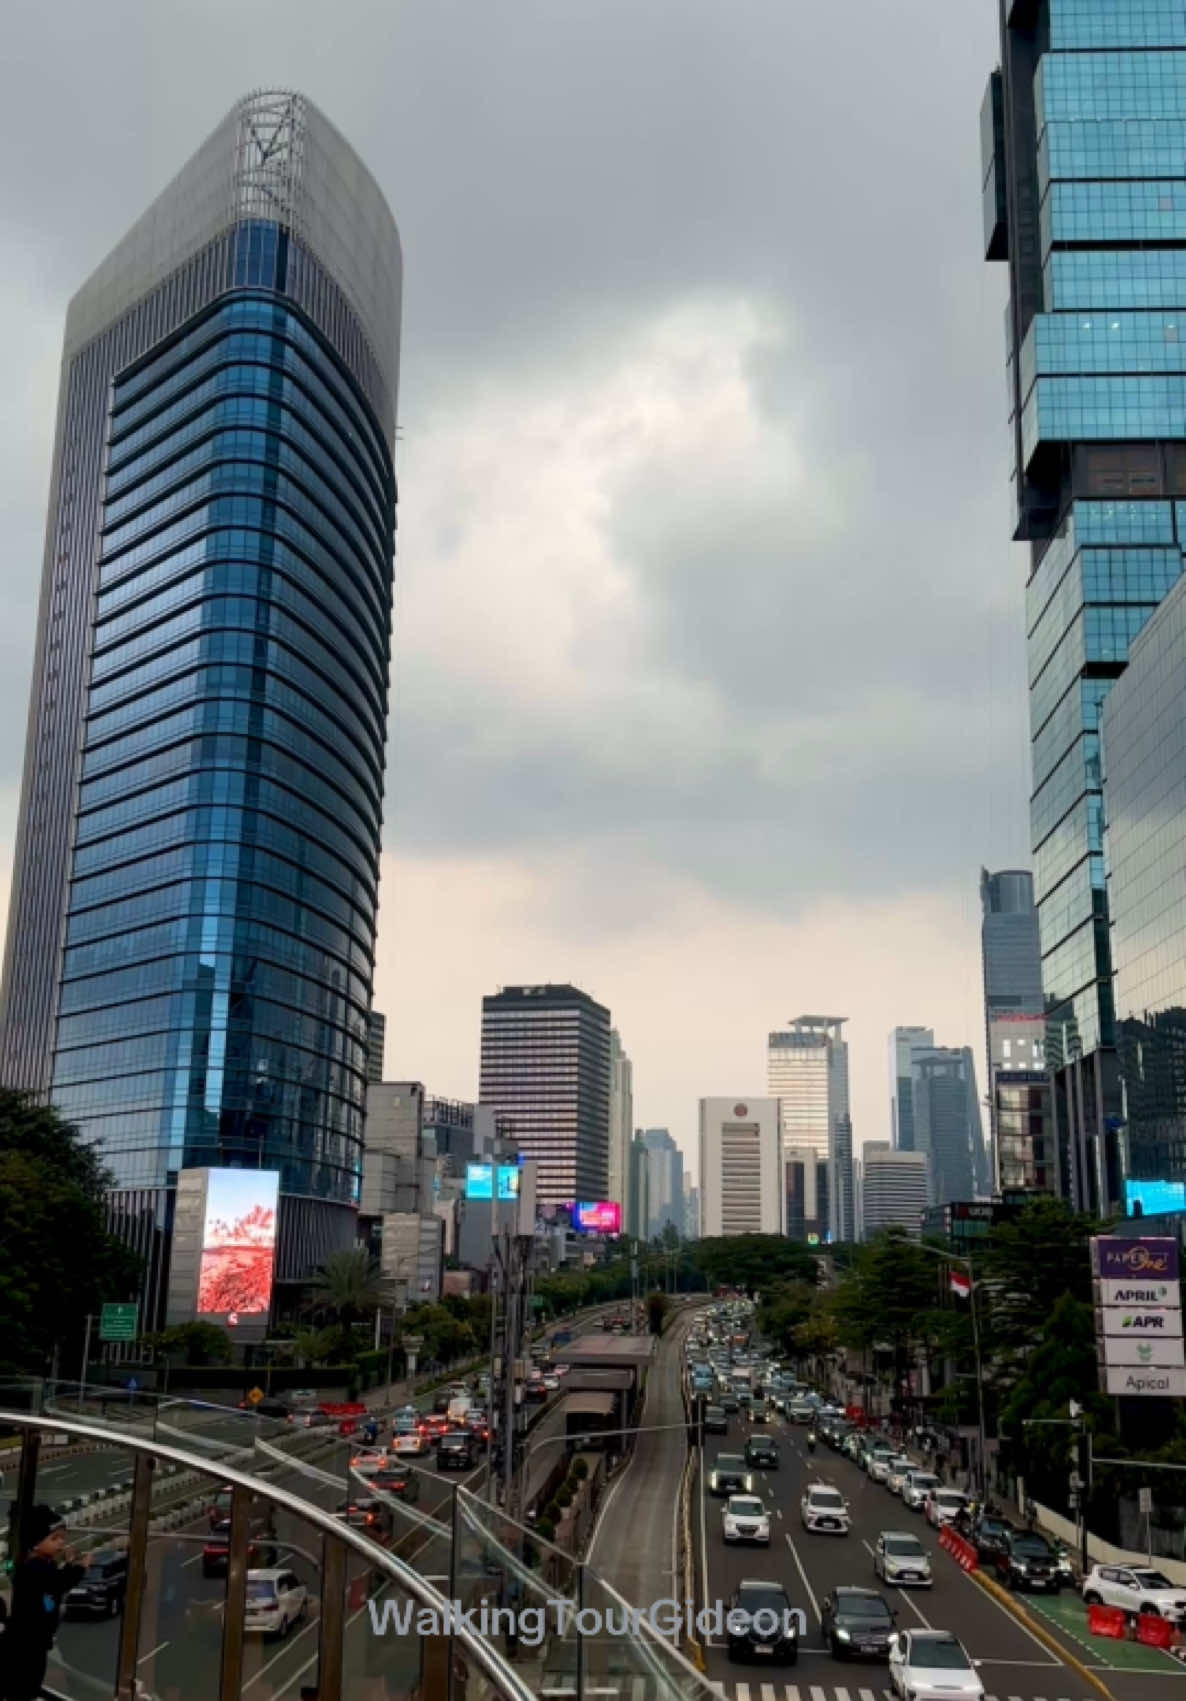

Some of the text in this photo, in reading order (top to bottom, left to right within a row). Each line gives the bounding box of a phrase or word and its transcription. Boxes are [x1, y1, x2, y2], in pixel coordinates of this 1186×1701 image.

[1114, 1289, 1158, 1302] APRIL
[1133, 1315, 1164, 1328] APR
[1126, 1375, 1169, 1391] Apical
